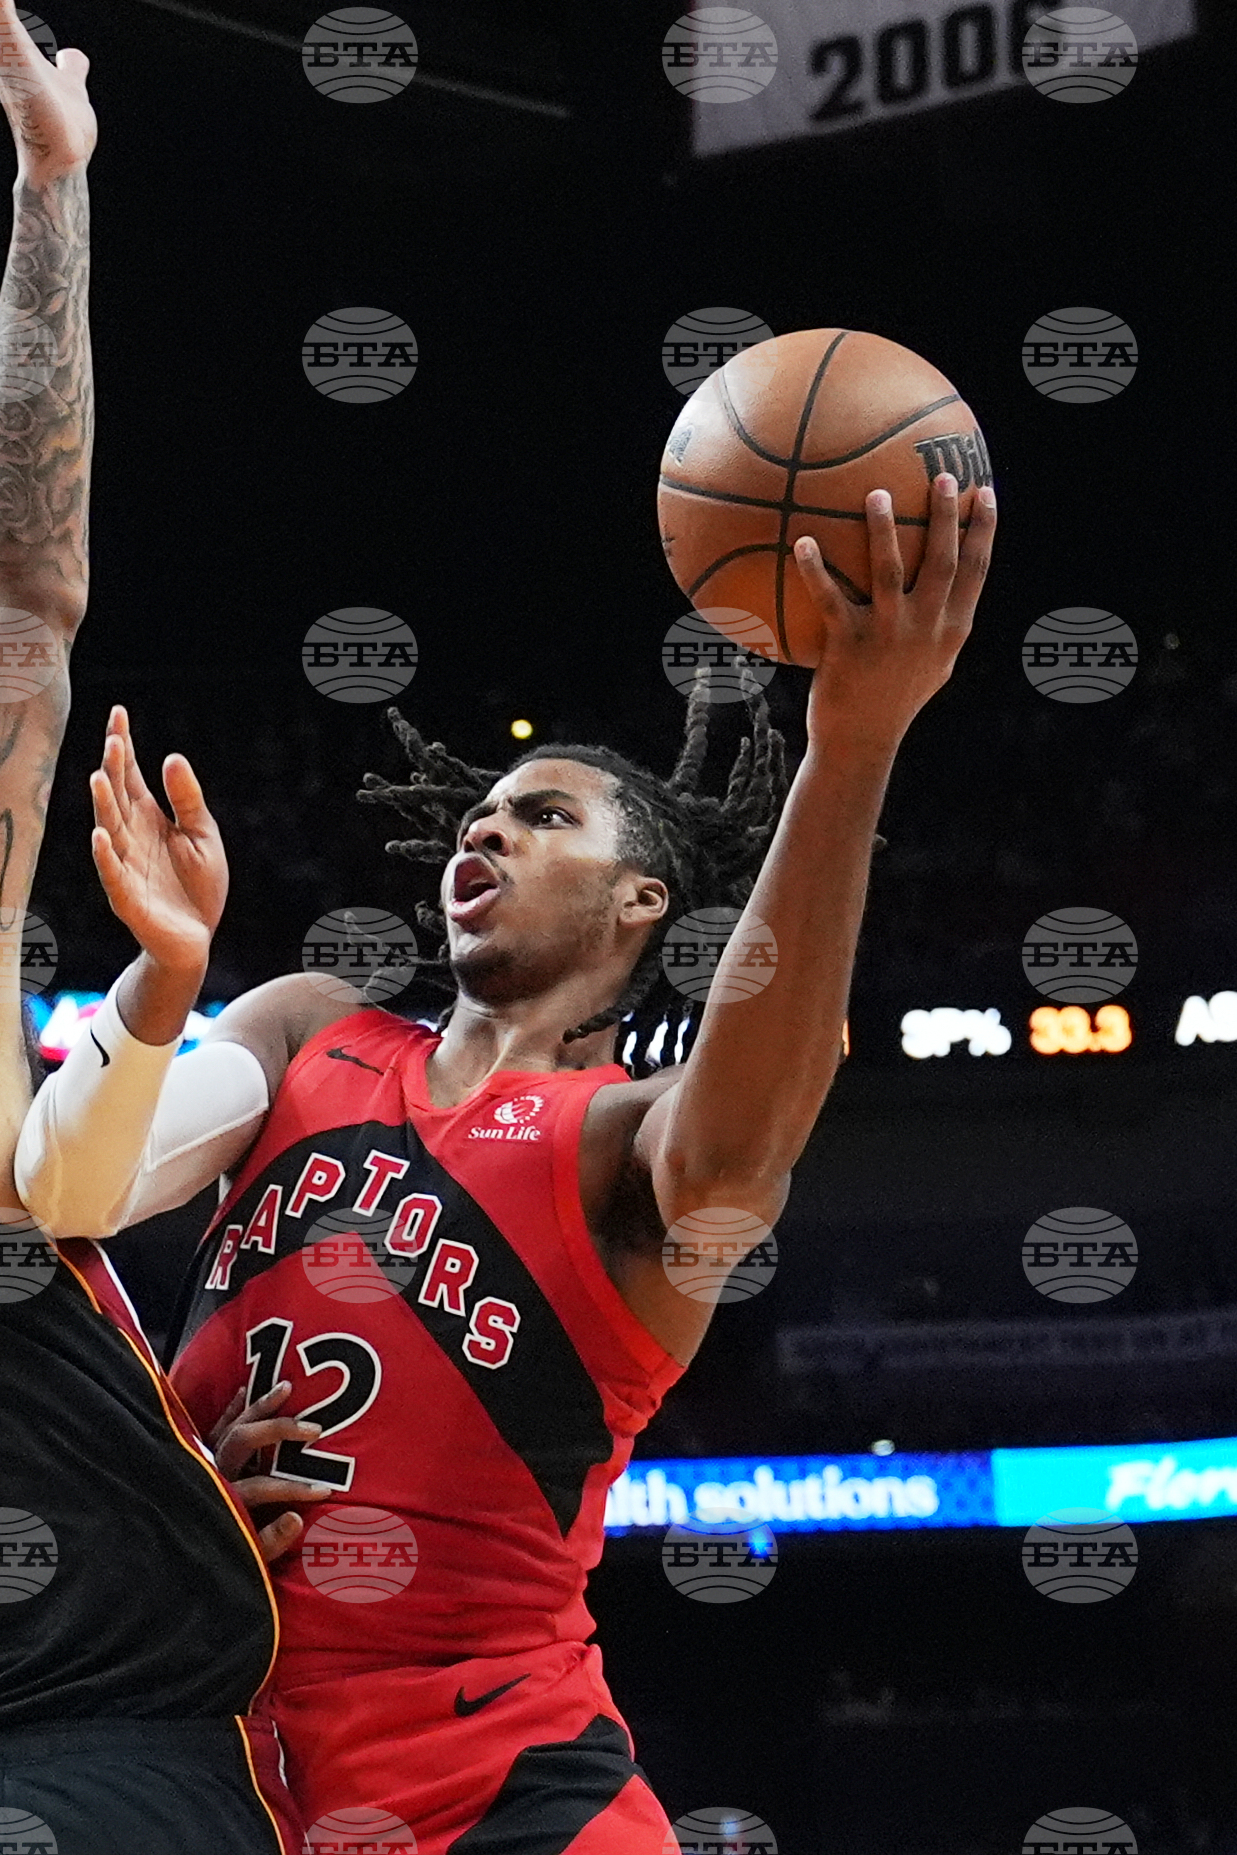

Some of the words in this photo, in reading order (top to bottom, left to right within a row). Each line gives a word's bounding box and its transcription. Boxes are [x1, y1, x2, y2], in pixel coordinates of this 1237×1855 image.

[467, 1126, 504, 1139] Sun
[505, 1125, 541, 1141] Life
[204, 1149, 521, 1369] RAPTORS
[245, 1316, 382, 1493] 12
[693, 1465, 939, 1522] solutions
